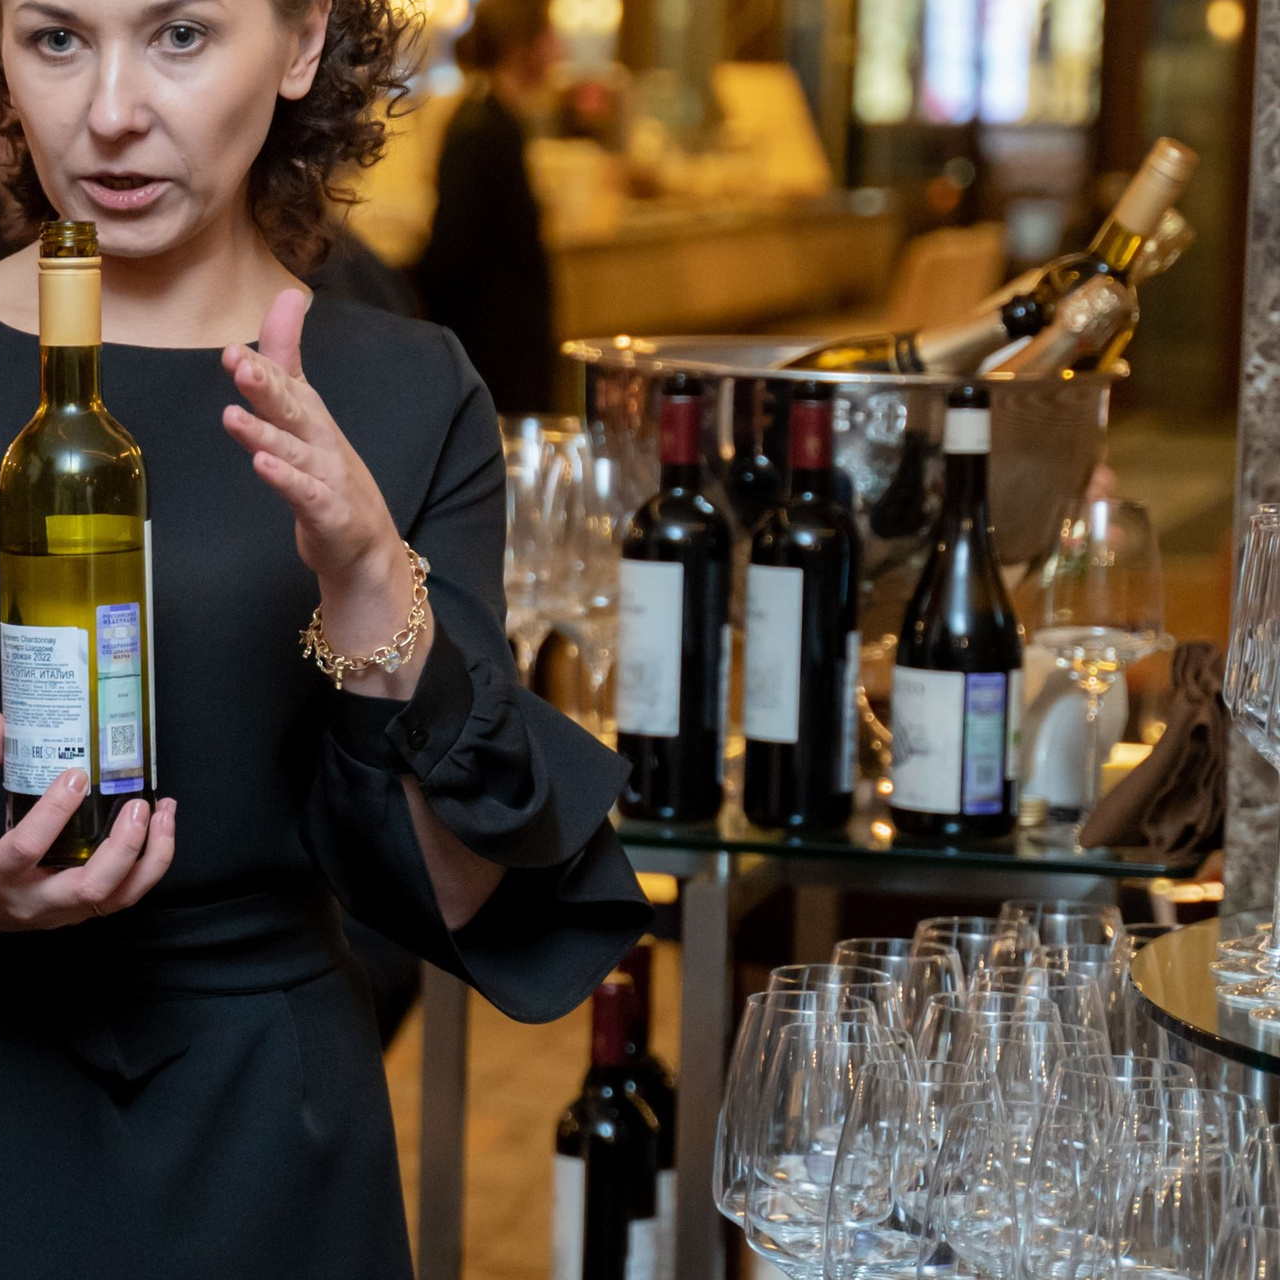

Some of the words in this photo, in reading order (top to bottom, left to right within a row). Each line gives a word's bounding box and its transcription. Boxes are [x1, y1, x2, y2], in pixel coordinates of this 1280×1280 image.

[21, 635, 56, 645] Chardonnay
[33, 652, 52, 662] 2022
[39, 670, 75, 680] ИТАЛИЯ
